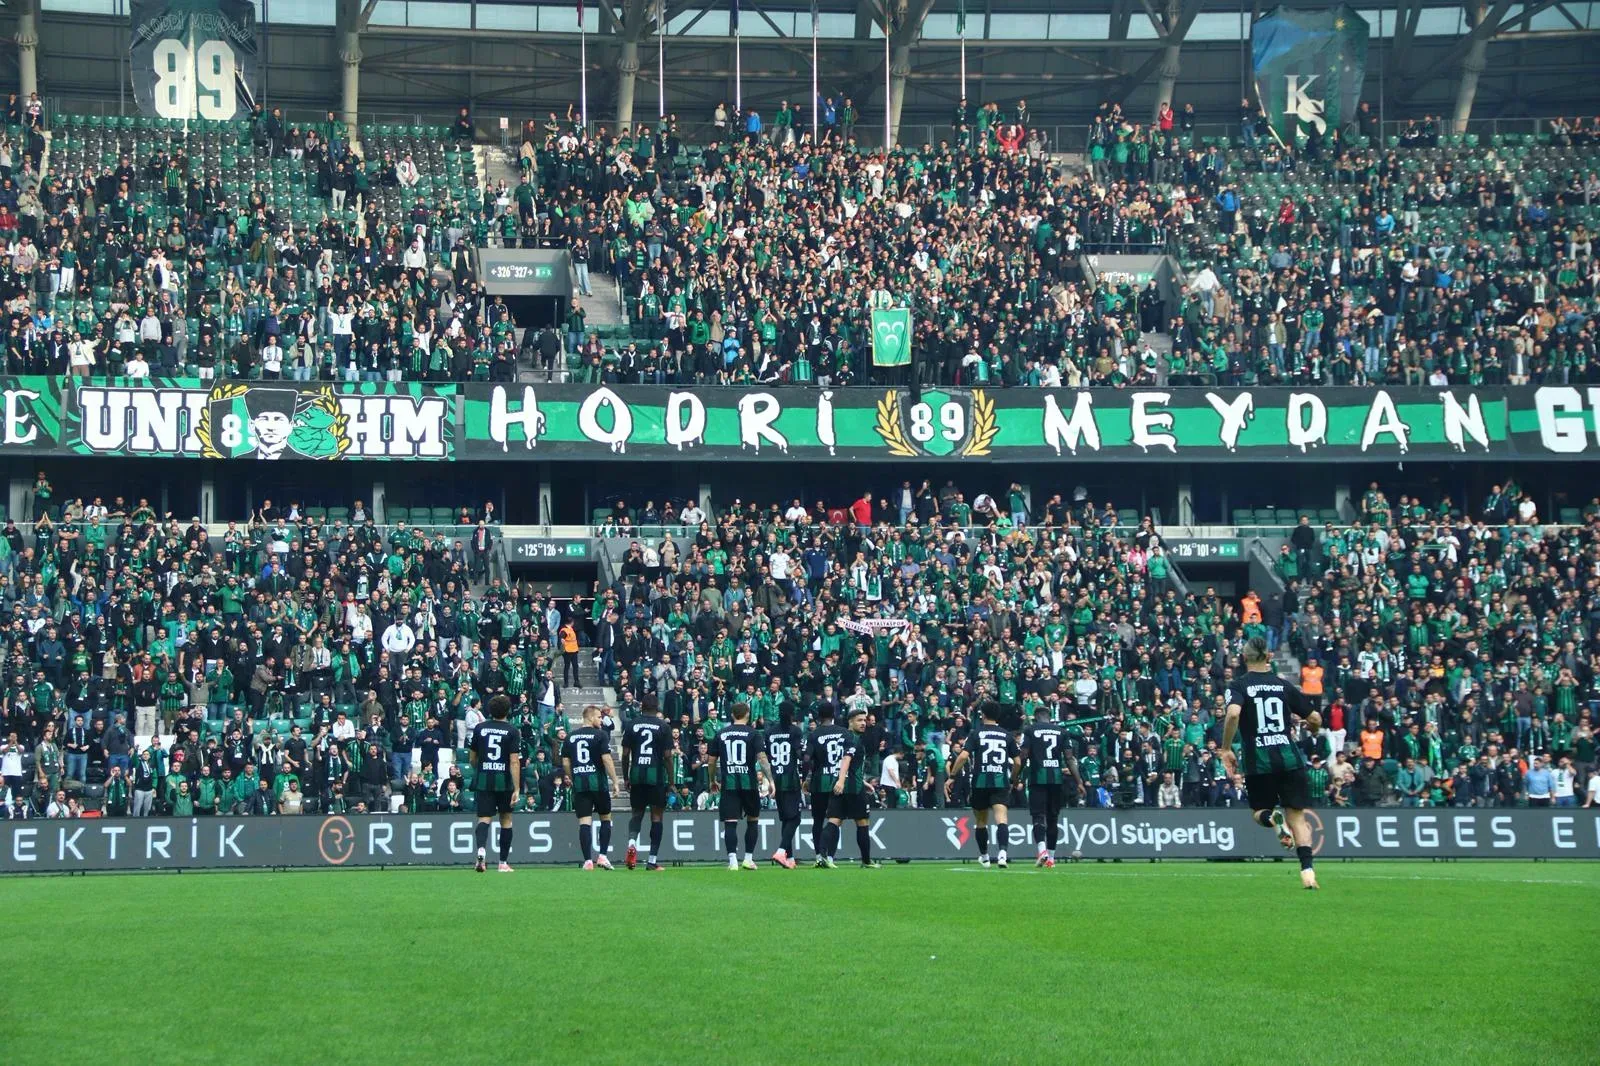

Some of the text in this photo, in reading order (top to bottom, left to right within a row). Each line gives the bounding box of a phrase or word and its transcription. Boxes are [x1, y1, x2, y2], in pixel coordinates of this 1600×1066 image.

[153, 39, 236, 119] 89
[910, 402, 964, 442] 89
[1044, 390, 1489, 455] MEYDAN
[524, 543, 557, 557] 125 126
[1254, 697, 1285, 734] 19
[487, 734, 502, 761] 5
[576, 740, 590, 764] 6
[640, 729, 653, 755] 2
[724, 739, 747, 766] 10
[770, 741, 791, 766] 98
[979, 738, 1007, 764] 75
[1043, 735, 1057, 759] 7
[13, 818, 245, 862] EKTRİK
[1336, 816, 1516, 849] REGES
